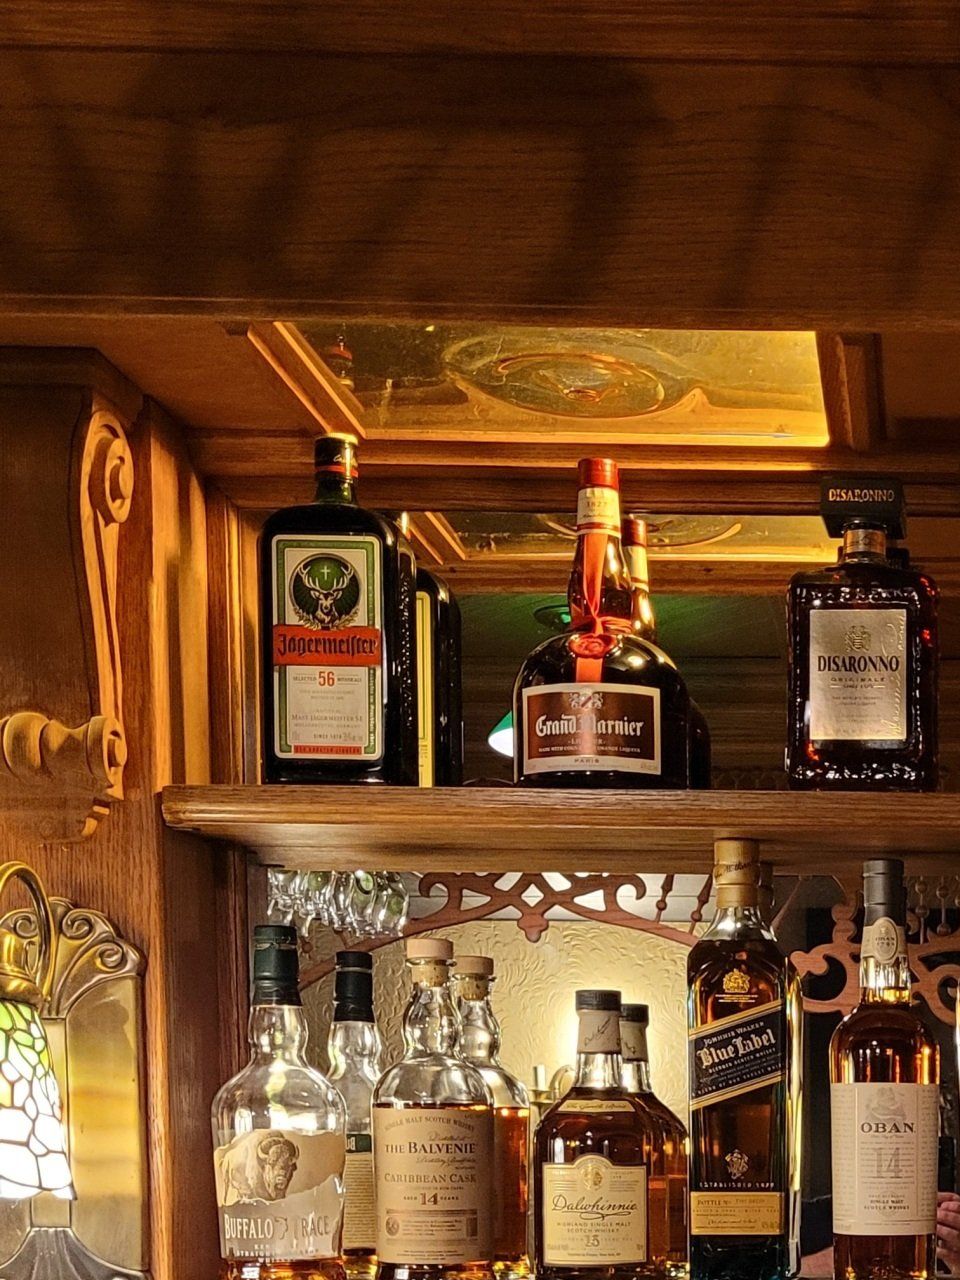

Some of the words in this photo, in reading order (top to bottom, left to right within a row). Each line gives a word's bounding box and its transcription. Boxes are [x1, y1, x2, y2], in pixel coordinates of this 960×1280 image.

[828, 489, 895, 502] DISARONNO
[817, 655, 899, 673] DISARONNO
[318, 671, 335, 687] 56
[535, 714, 577, 737] Grand
[703, 1031, 736, 1047] JOHNNIE
[736, 1021, 765, 1035] WALKER
[696, 1044, 736, 1069] Blue
[732, 1028, 777, 1057] Label
[405, 1115, 422, 1124] MALT
[425, 1115, 451, 1124] SCOTCH
[861, 1122, 915, 1133] OBAN
[385, 1143, 405, 1154] THE
[408, 1141, 476, 1154] BALVENIE
[872, 1147, 903, 1178] 14
[384, 1173, 447, 1183] CARIBBEAN
[450, 1173, 477, 1183] CASK
[420, 1192, 439, 1205] 14
[551, 1194, 638, 1213] Dalwhinnie
[224, 1214, 274, 1239] BUFFALO
[583, 1234, 600, 1248] 15
